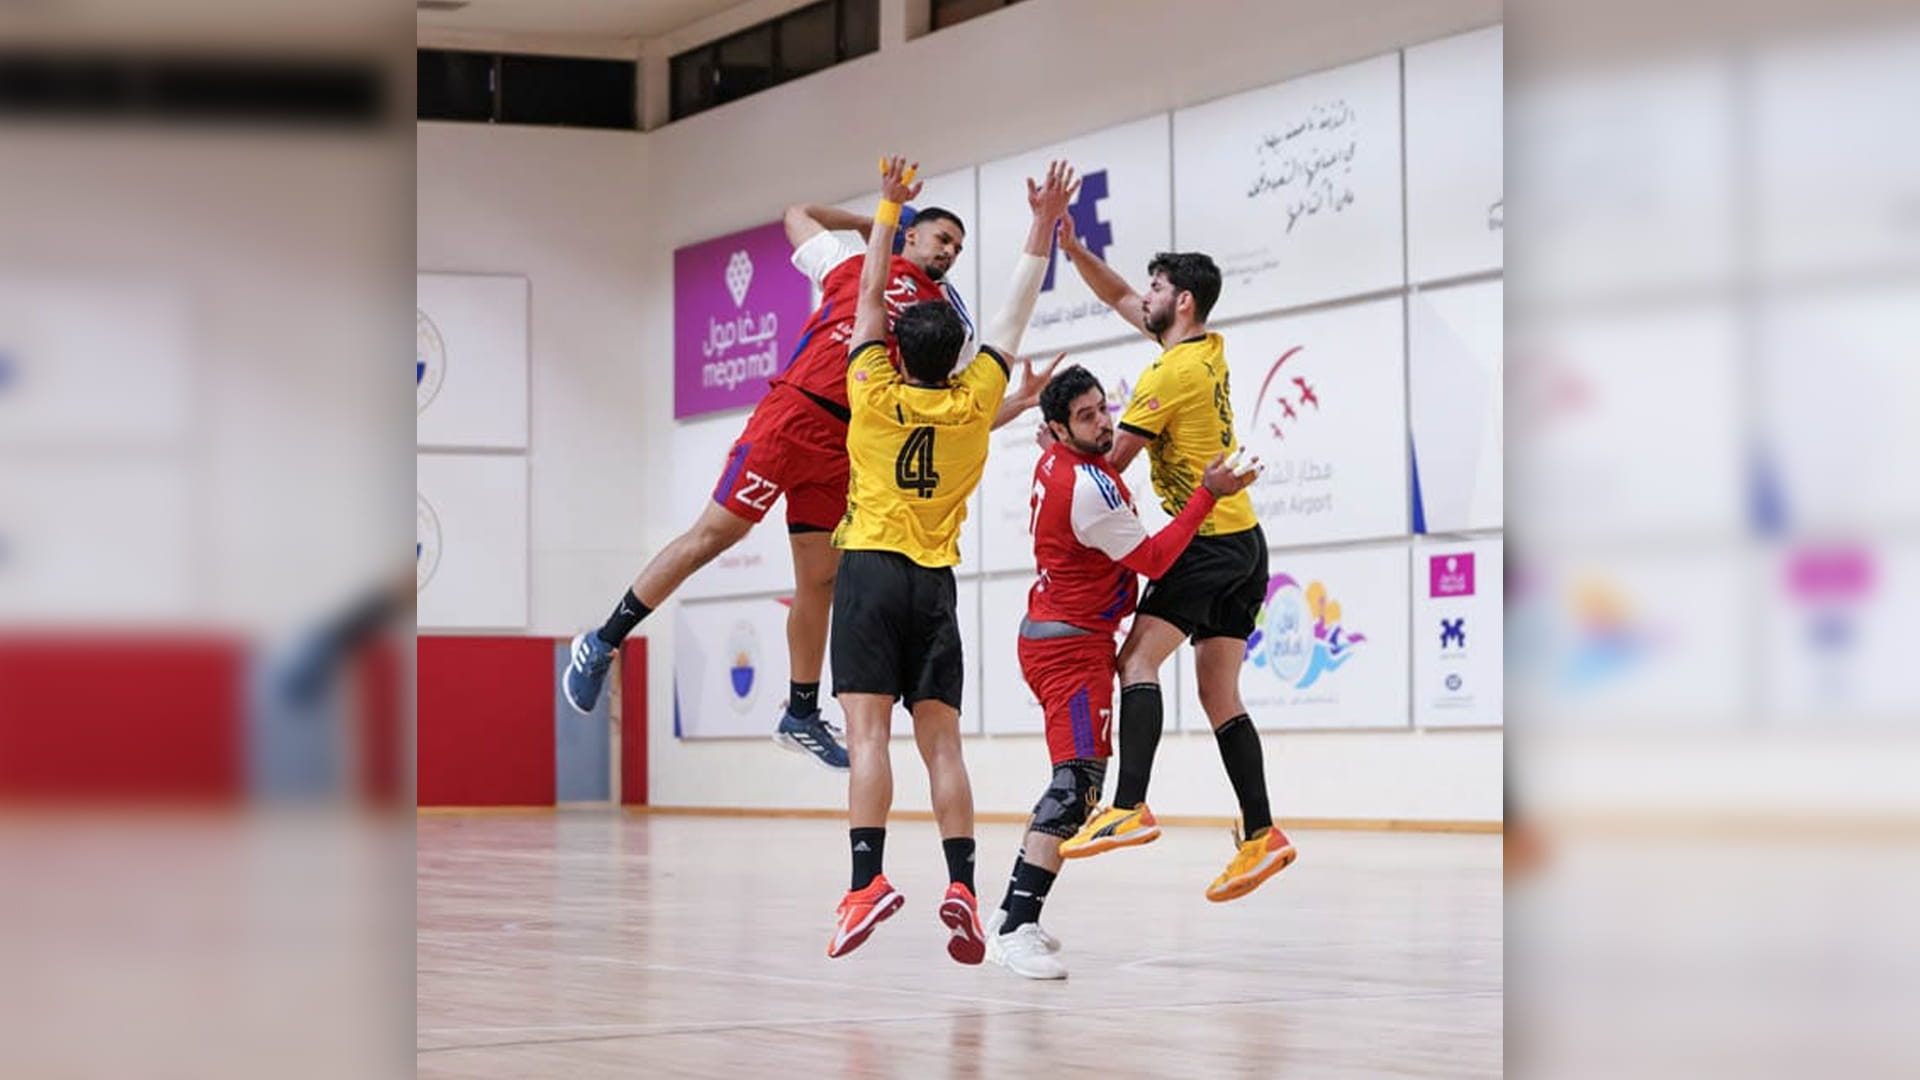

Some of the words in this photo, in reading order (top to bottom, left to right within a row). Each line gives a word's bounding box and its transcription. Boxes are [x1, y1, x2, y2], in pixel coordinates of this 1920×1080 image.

[703, 357, 746, 391] mega
[748, 340, 778, 379] mall
[895, 426, 939, 499] 4
[736, 471, 778, 510] 22
[1099, 708, 1111, 742] 7
